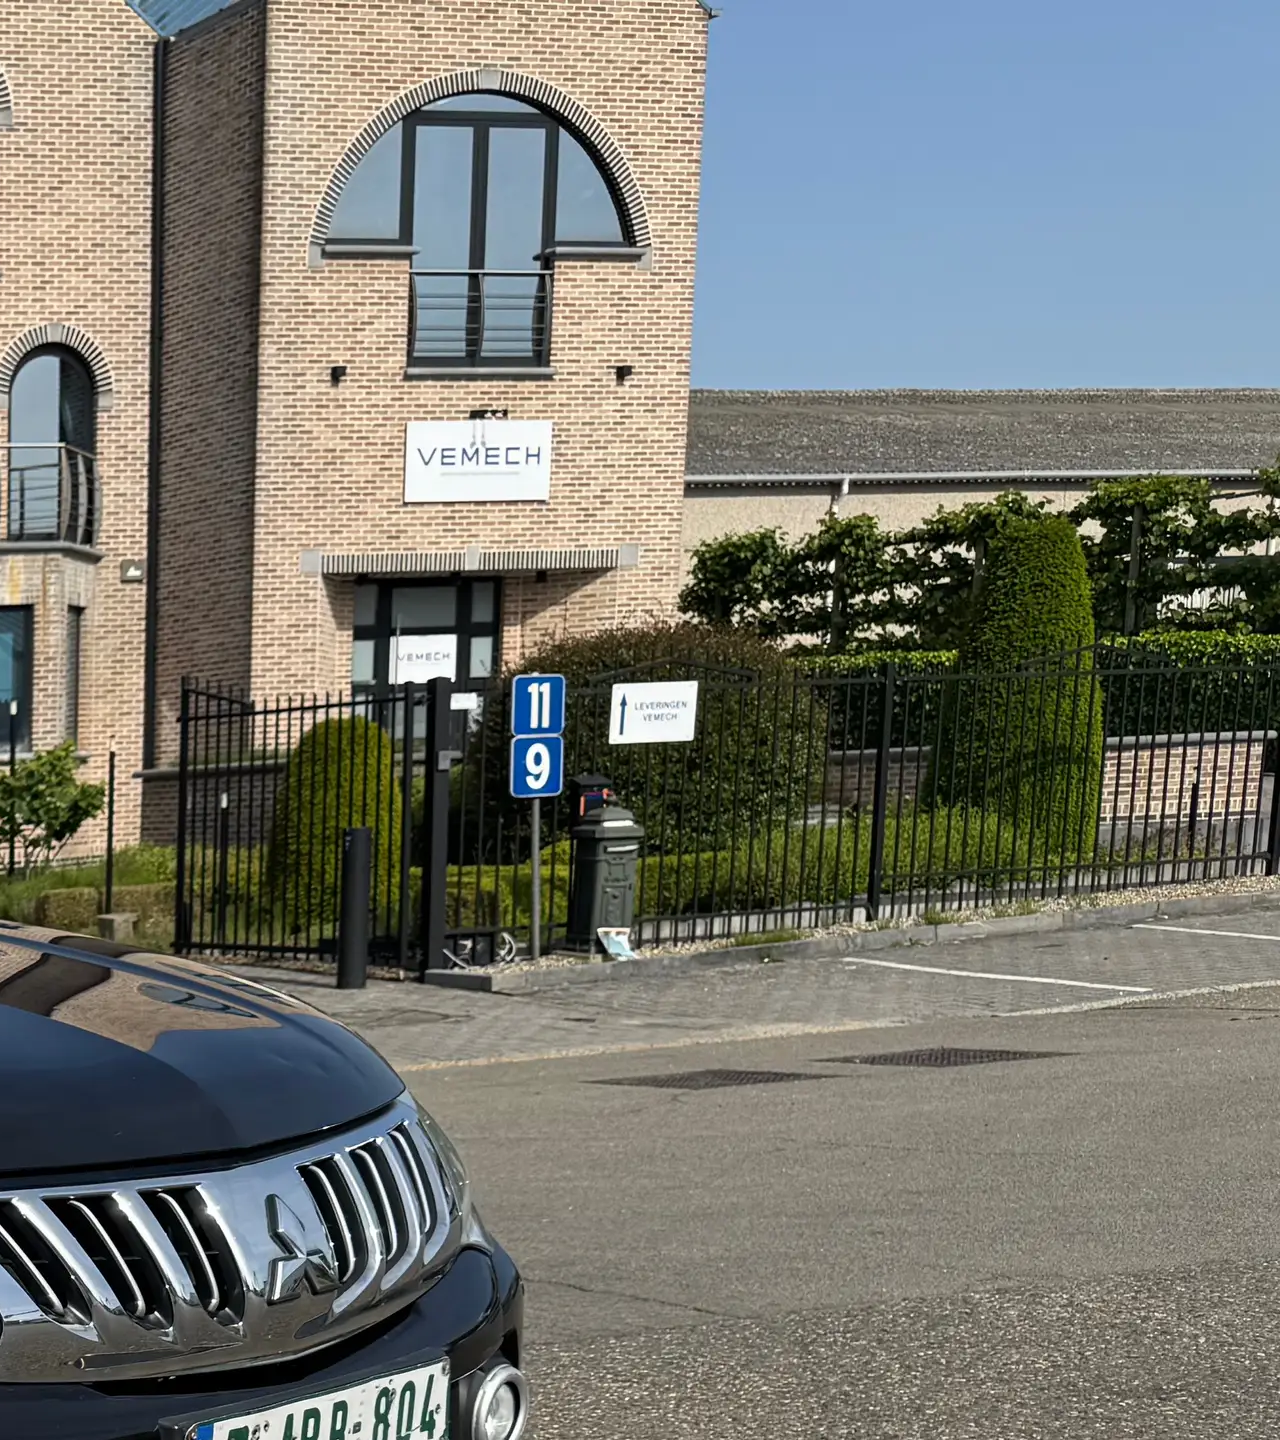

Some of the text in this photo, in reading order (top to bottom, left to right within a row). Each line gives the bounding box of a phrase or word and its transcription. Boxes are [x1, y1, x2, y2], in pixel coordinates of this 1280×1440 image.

[417, 446, 541, 466] VEMECH
[397, 652, 450, 662] VEMECH
[528, 682, 551, 729] 11
[634, 700, 688, 711] LEVERINGEN
[642, 712, 678, 722] VEMECH
[525, 742, 551, 789] 9
